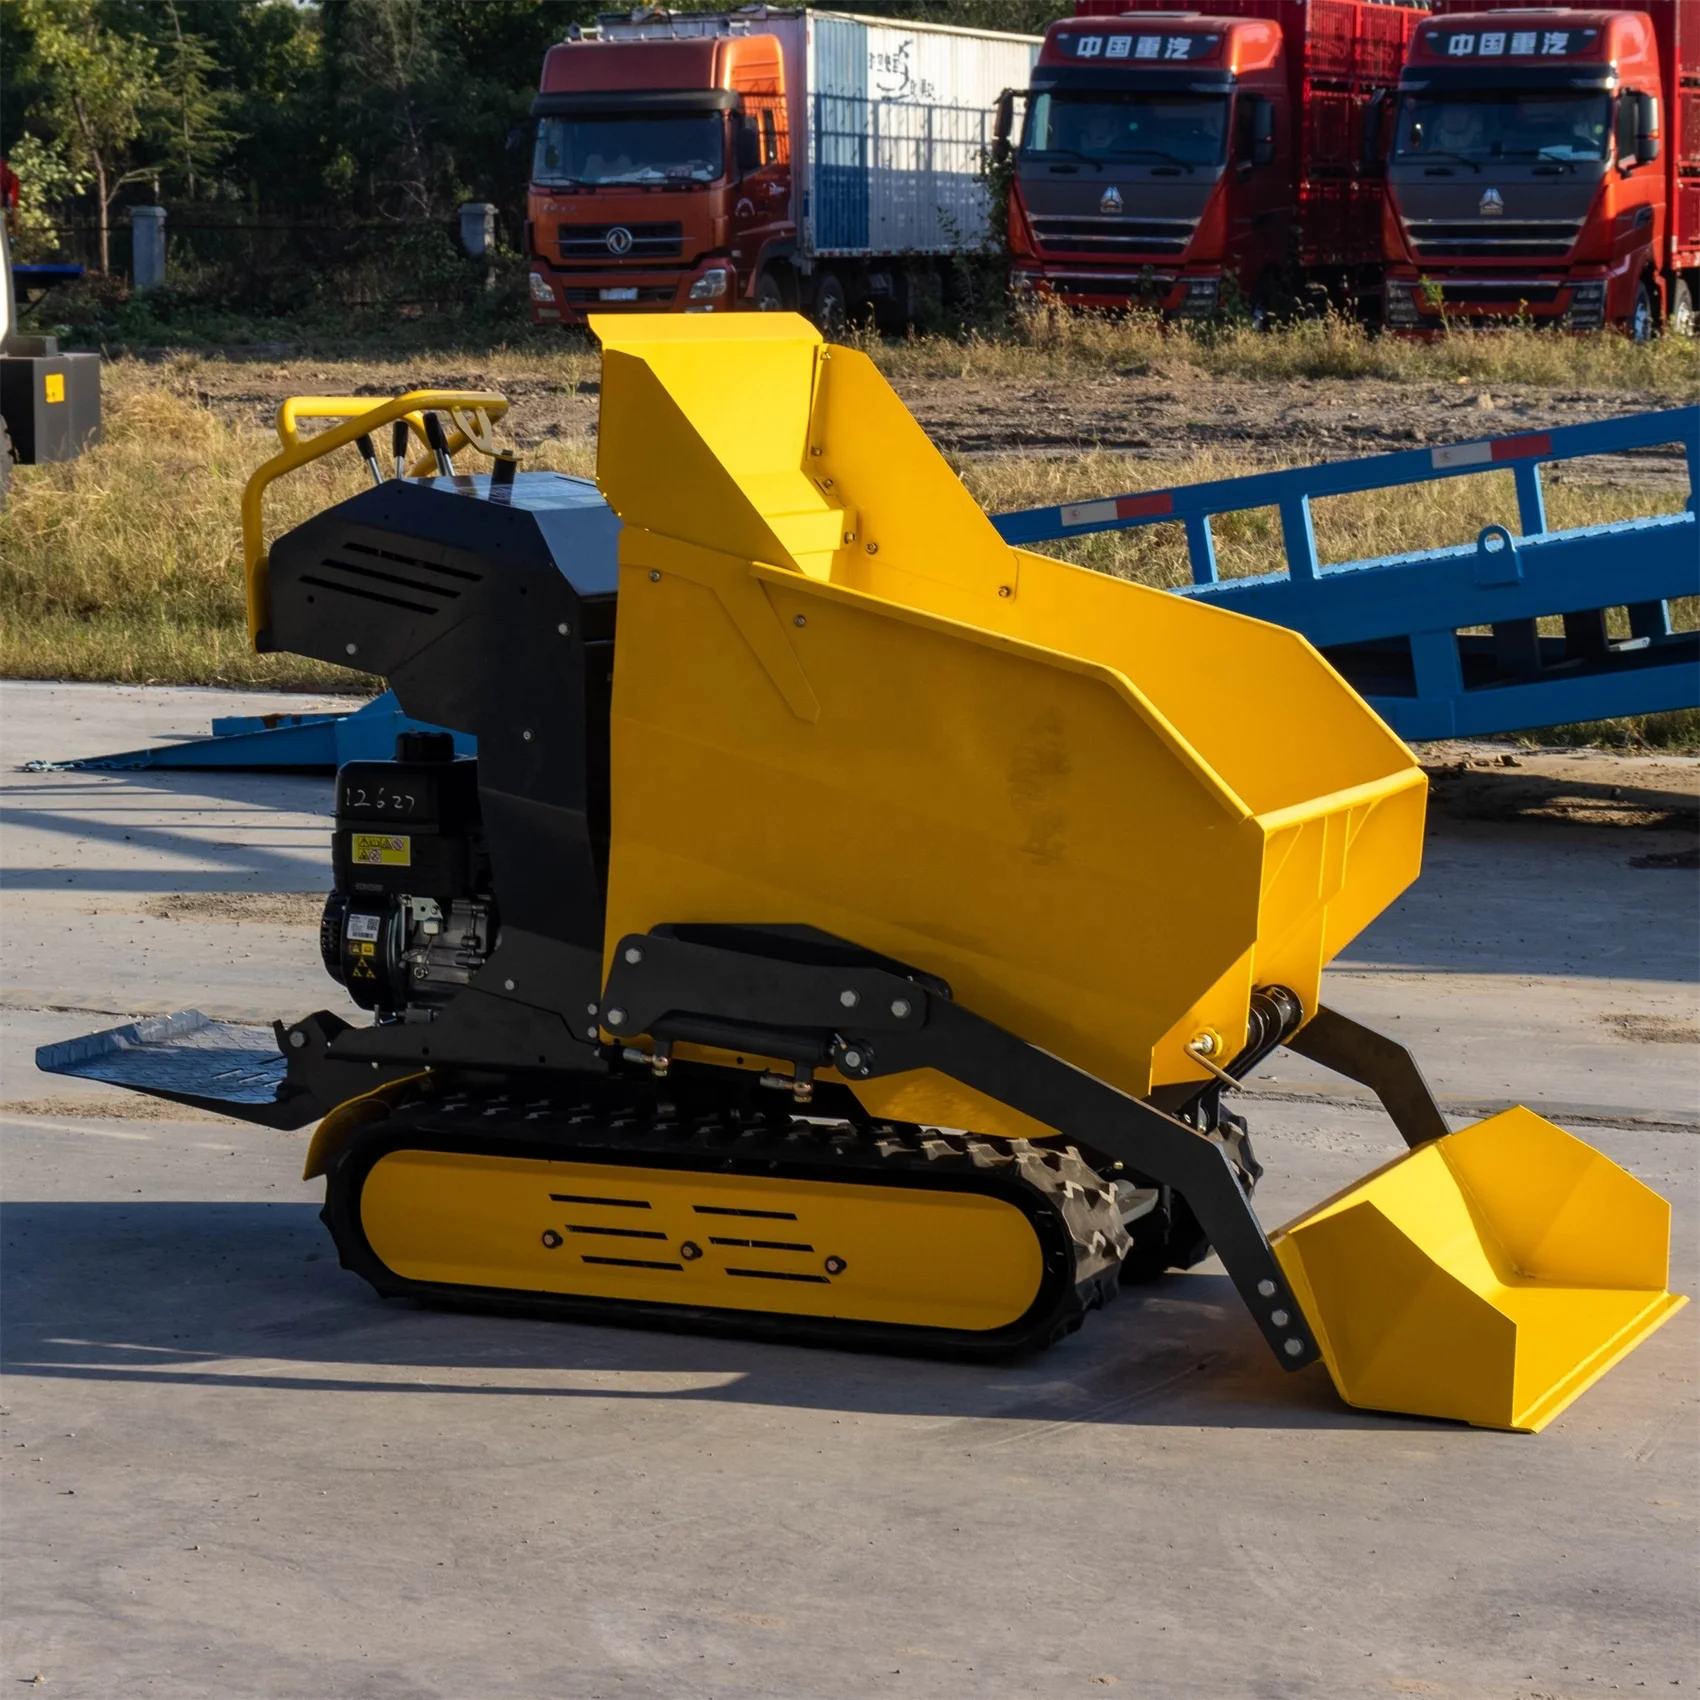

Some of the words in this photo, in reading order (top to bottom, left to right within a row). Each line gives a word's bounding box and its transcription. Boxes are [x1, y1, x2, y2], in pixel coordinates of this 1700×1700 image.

[1076, 35, 1192, 59] 中国重汽
[1448, 31, 1569, 57] 中国重汽
[346, 786, 415, 813] 12627
